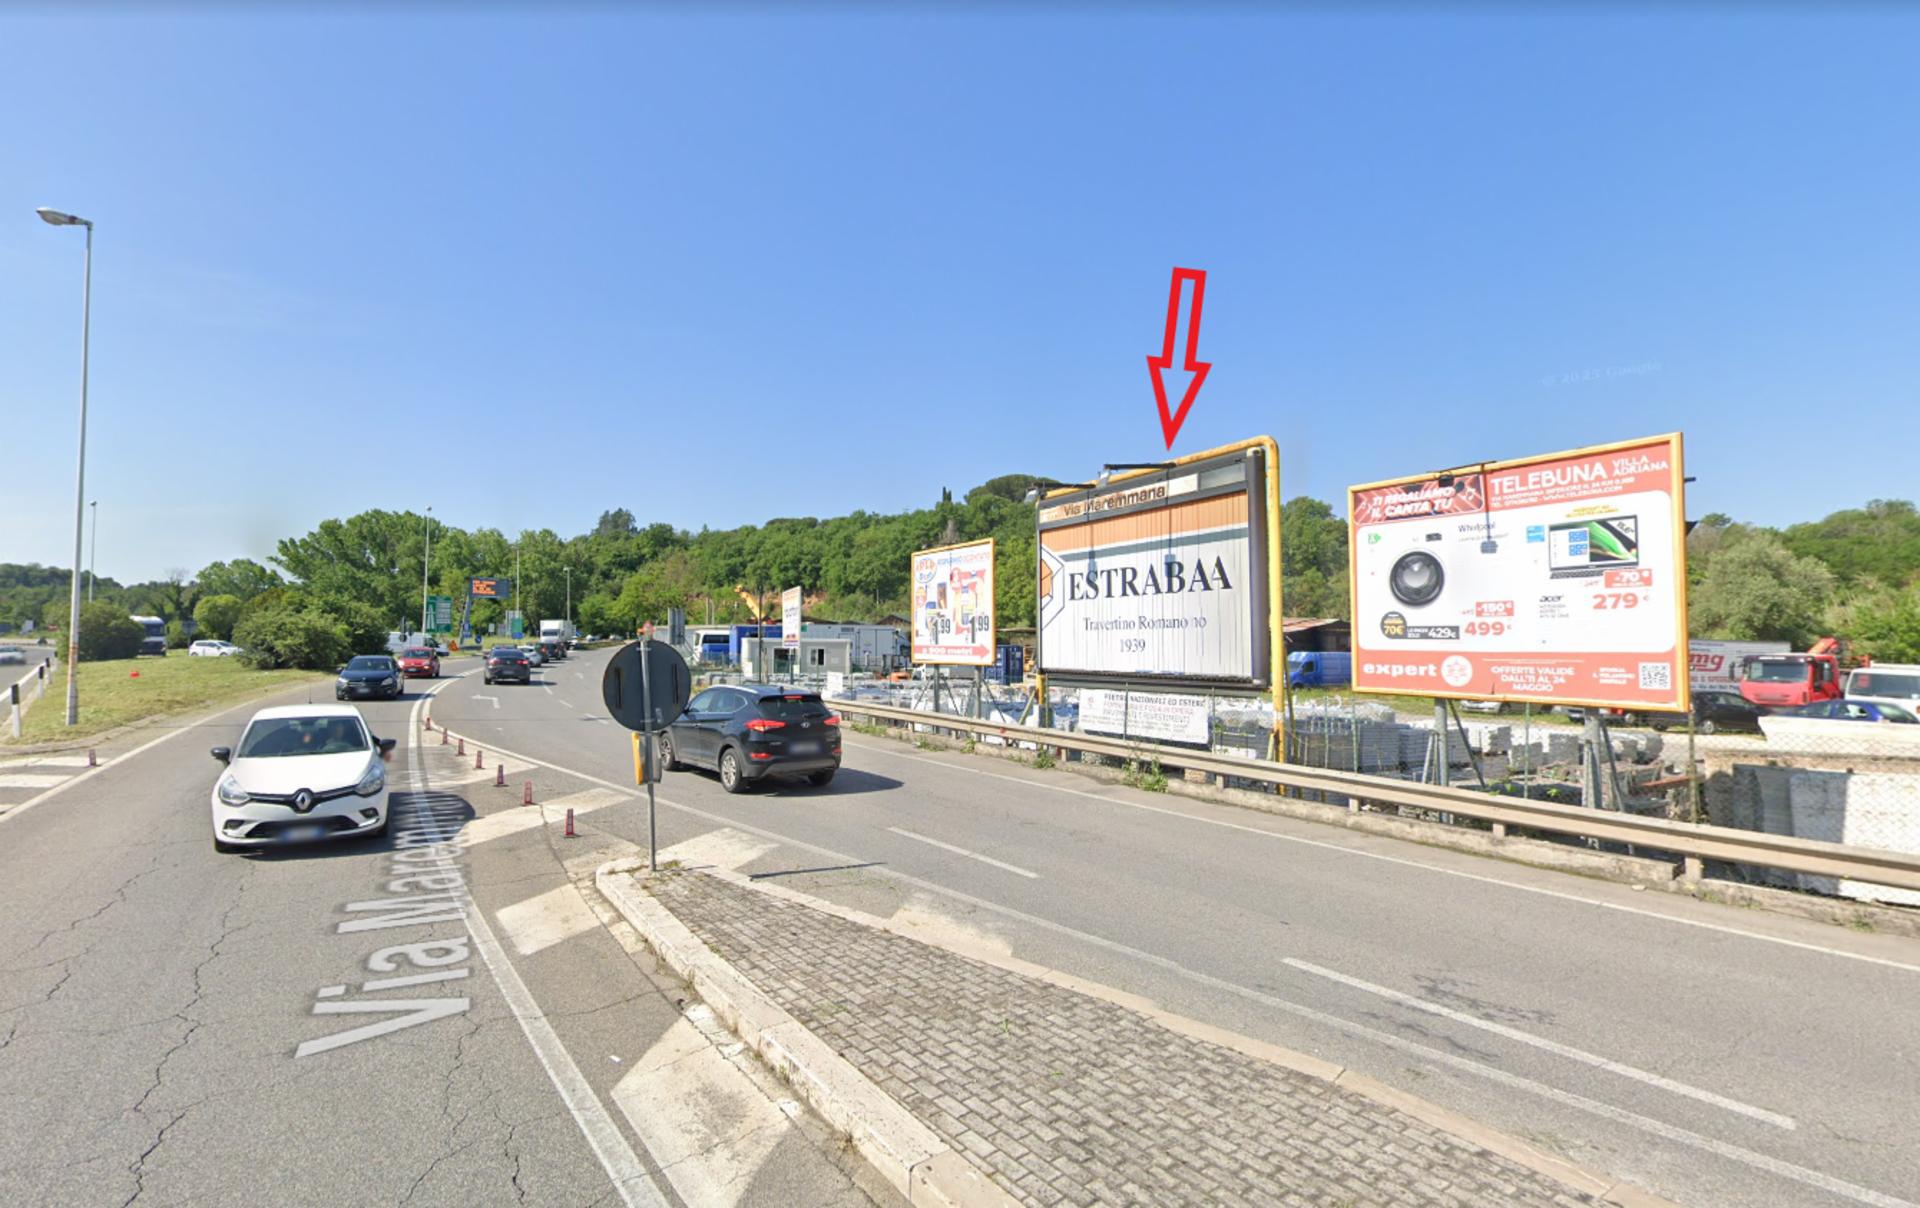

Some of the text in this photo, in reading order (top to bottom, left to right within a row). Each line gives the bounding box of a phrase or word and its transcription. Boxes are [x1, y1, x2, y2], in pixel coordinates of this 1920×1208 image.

[1612, 455, 1649, 468] VILLA
[1613, 460, 1668, 476] ADRIANA
[1490, 462, 1607, 495] TELEBUNA
[1063, 485, 1165, 517] Via Maremmana
[1371, 498, 1453, 518] IL CANTA TU
[1458, 522, 1496, 533] Whirlpool
[1477, 602, 1505, 612] -150
[1593, 592, 1638, 609] 279
[1083, 616, 1136, 631] Travertino
[1138, 615, 1189, 631] Romano
[1465, 621, 1505, 636] 499
[1383, 625, 1404, 635] 70€
[1119, 639, 1146, 652] 1939
[1363, 663, 1437, 677] expert
[1491, 666, 1575, 676] OFFERTE VALIDE
[1513, 683, 1553, 691] MAGGIO
[1130, 695, 1166, 705] NAZIONALI
